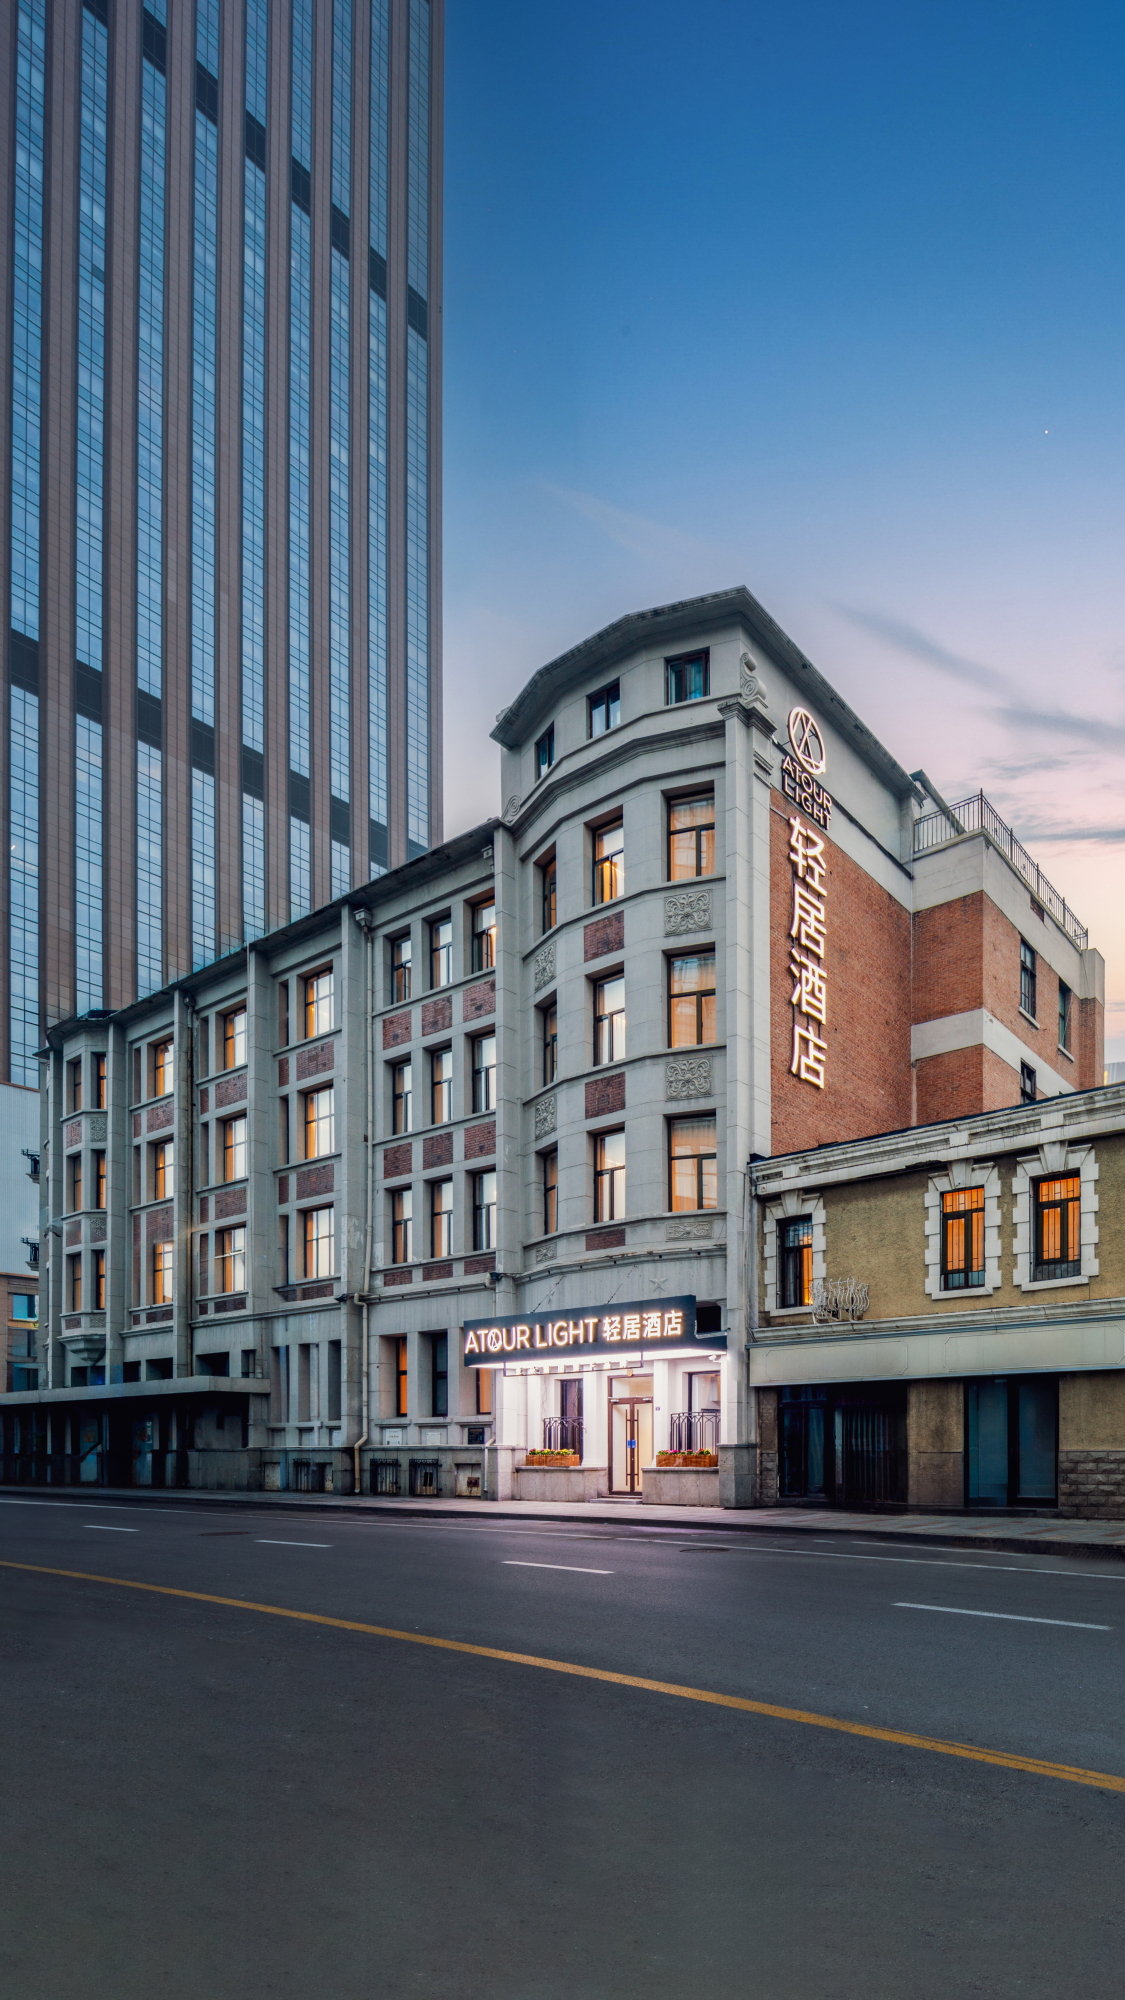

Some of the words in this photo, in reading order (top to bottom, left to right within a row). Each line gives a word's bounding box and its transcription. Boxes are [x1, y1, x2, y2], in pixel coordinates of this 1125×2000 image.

[782, 755, 833, 814] ATOUR
[784, 773, 832, 830] LIGHT
[789, 815, 828, 1089] 轻居酒店
[464, 1325, 531, 1354] ATOUR
[535, 1318, 599, 1348] LIGHT
[602, 1309, 683, 1342] 轻居酒店
